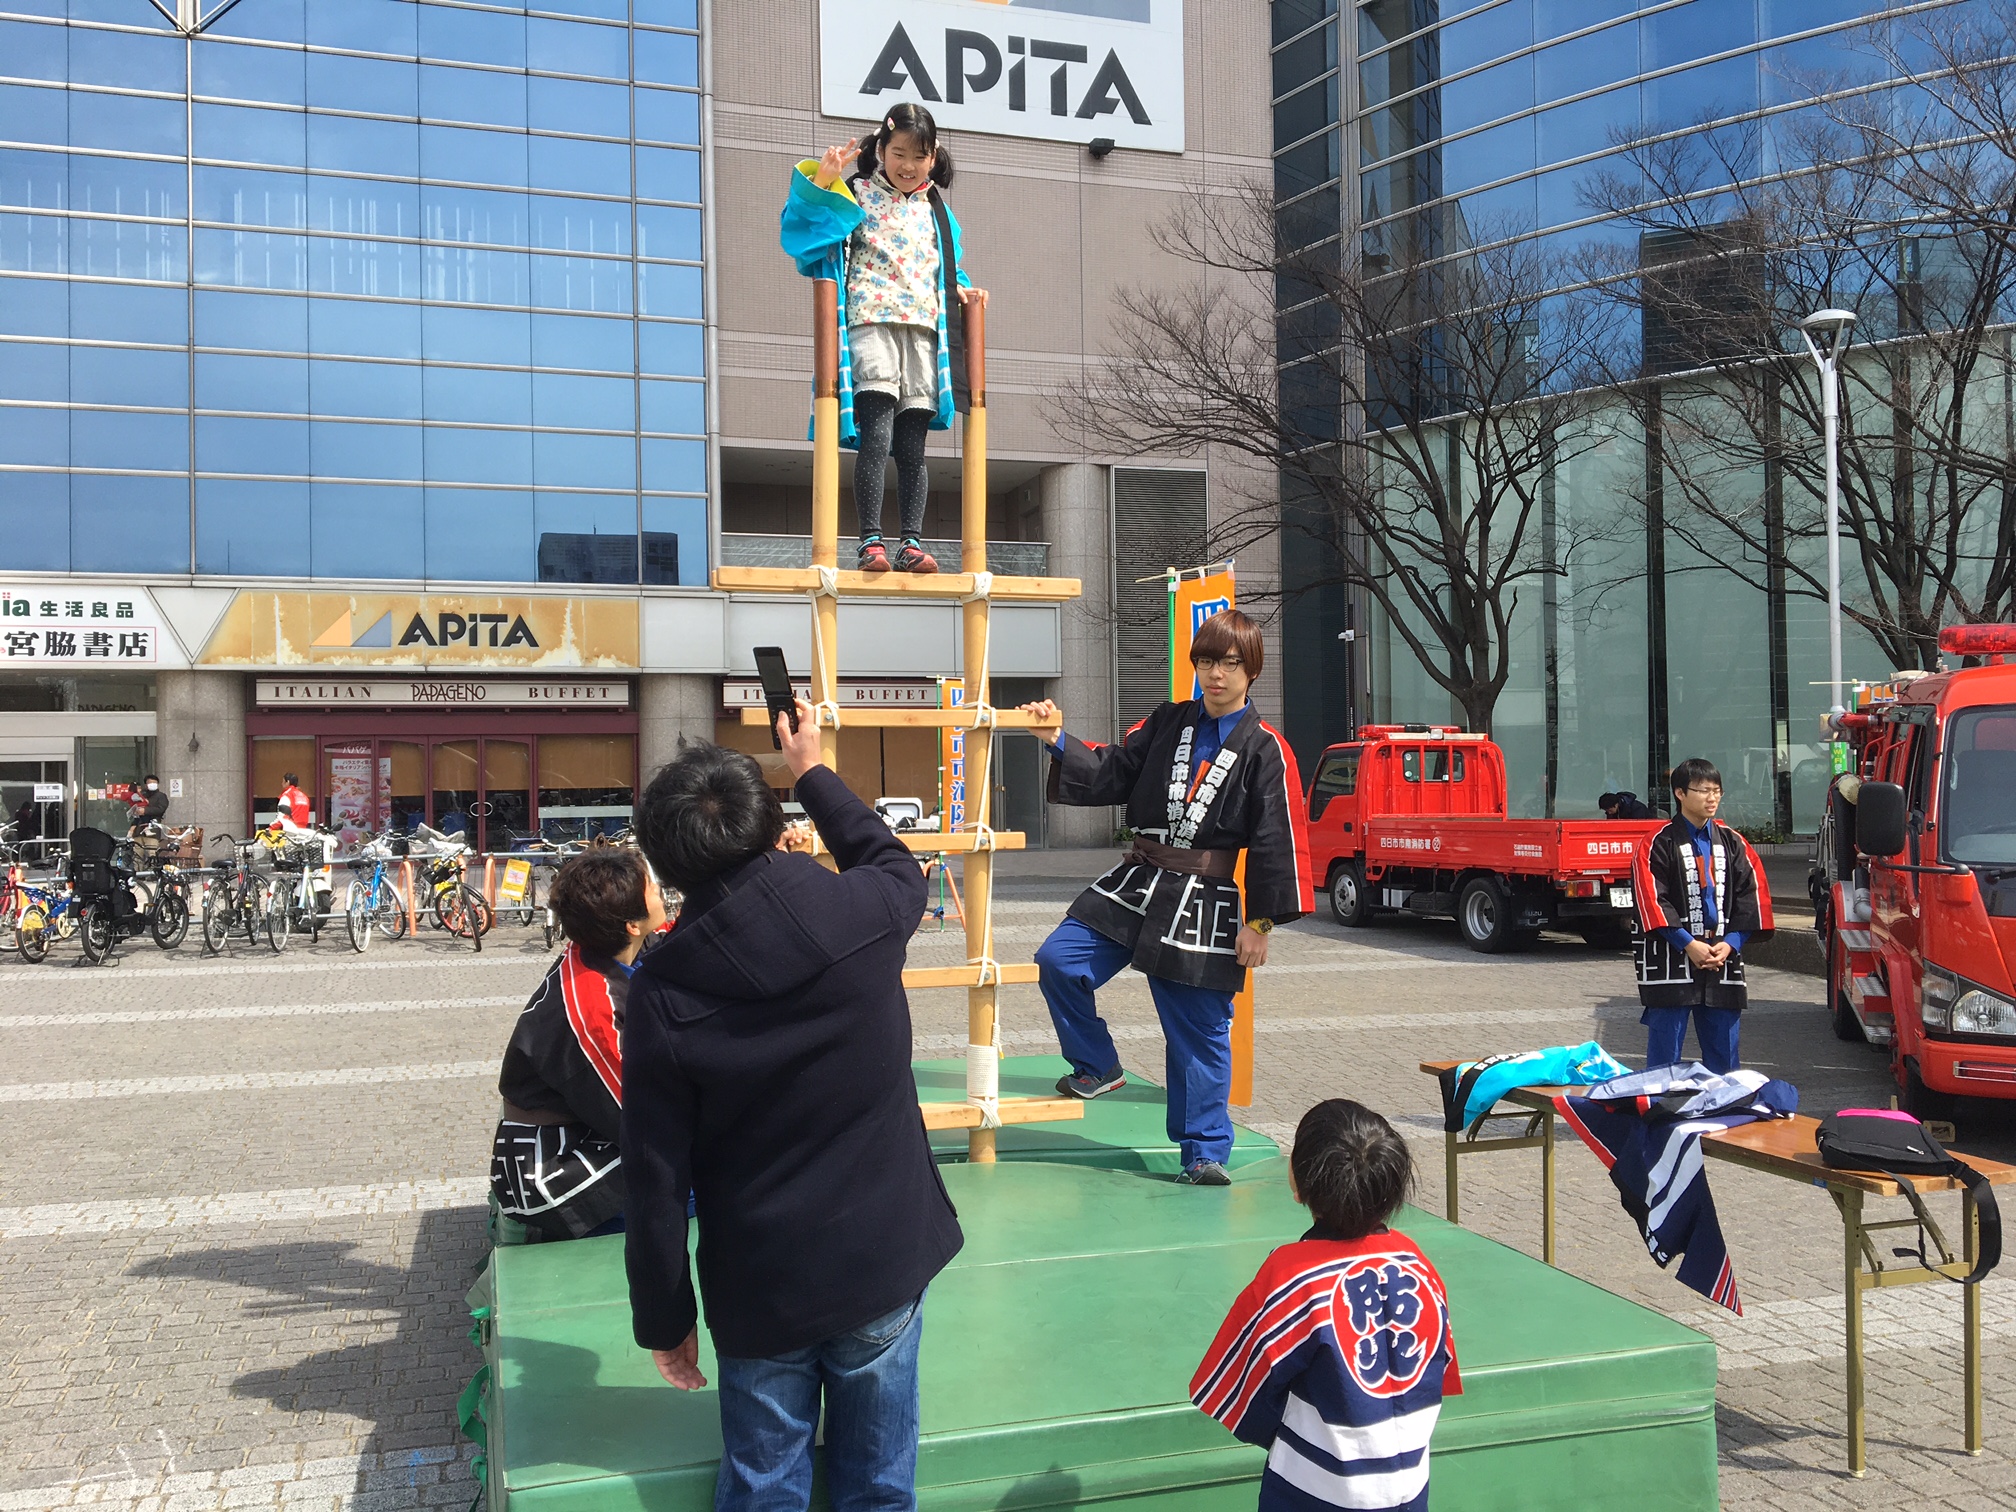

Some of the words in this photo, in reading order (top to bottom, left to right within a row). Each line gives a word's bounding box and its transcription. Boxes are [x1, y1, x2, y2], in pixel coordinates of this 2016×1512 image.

[39, 600, 134, 618] 生活良品
[4, 631, 149, 657] 宮脇書店
[273, 686, 372, 698] ITALIAN
[410, 683, 486, 702] PAPAGENO
[528, 687, 610, 699] BUFFET
[743, 689, 812, 700] ITIA
[856, 689, 928, 700] BUFFET
[1587, 841, 1633, 855] 四日市市
